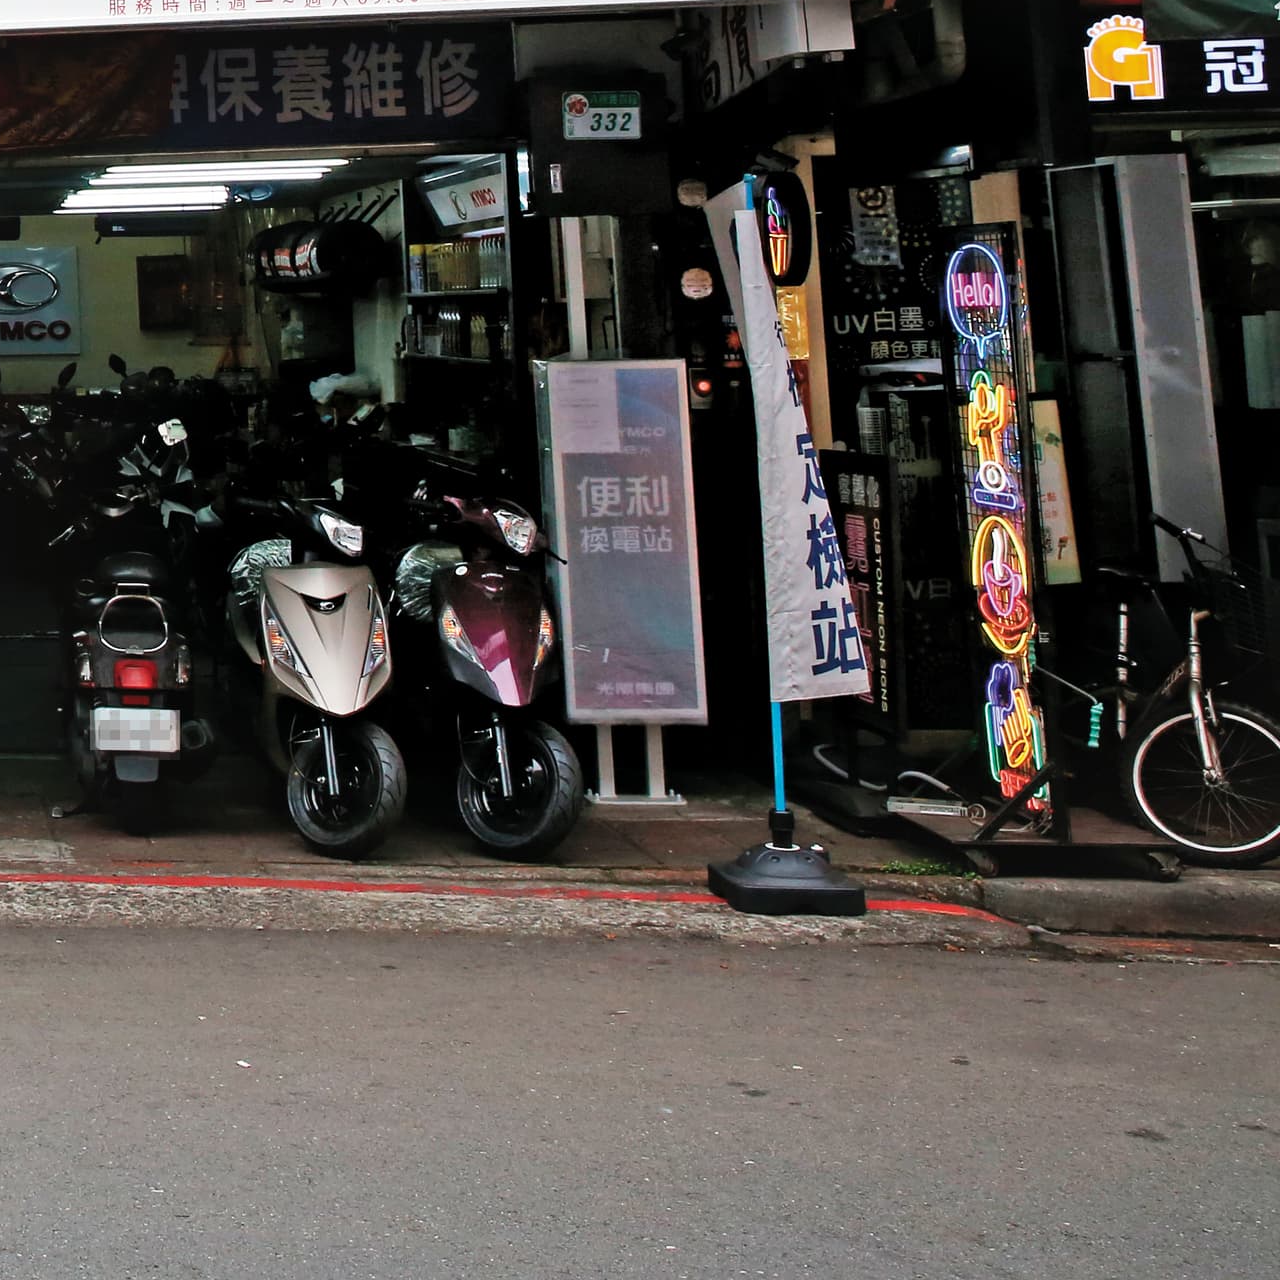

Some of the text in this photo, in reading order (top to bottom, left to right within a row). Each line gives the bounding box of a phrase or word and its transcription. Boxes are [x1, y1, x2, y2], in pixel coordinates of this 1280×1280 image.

[1203, 38, 1268, 94] 冠
[590, 112, 632, 132] 332
[618, 426, 666, 438] YMCO
[577, 475, 670, 519] 便利
[580, 525, 672, 553] 換電站
[873, 517, 883, 596] CUSTOM
[876, 600, 887, 653] NEON
